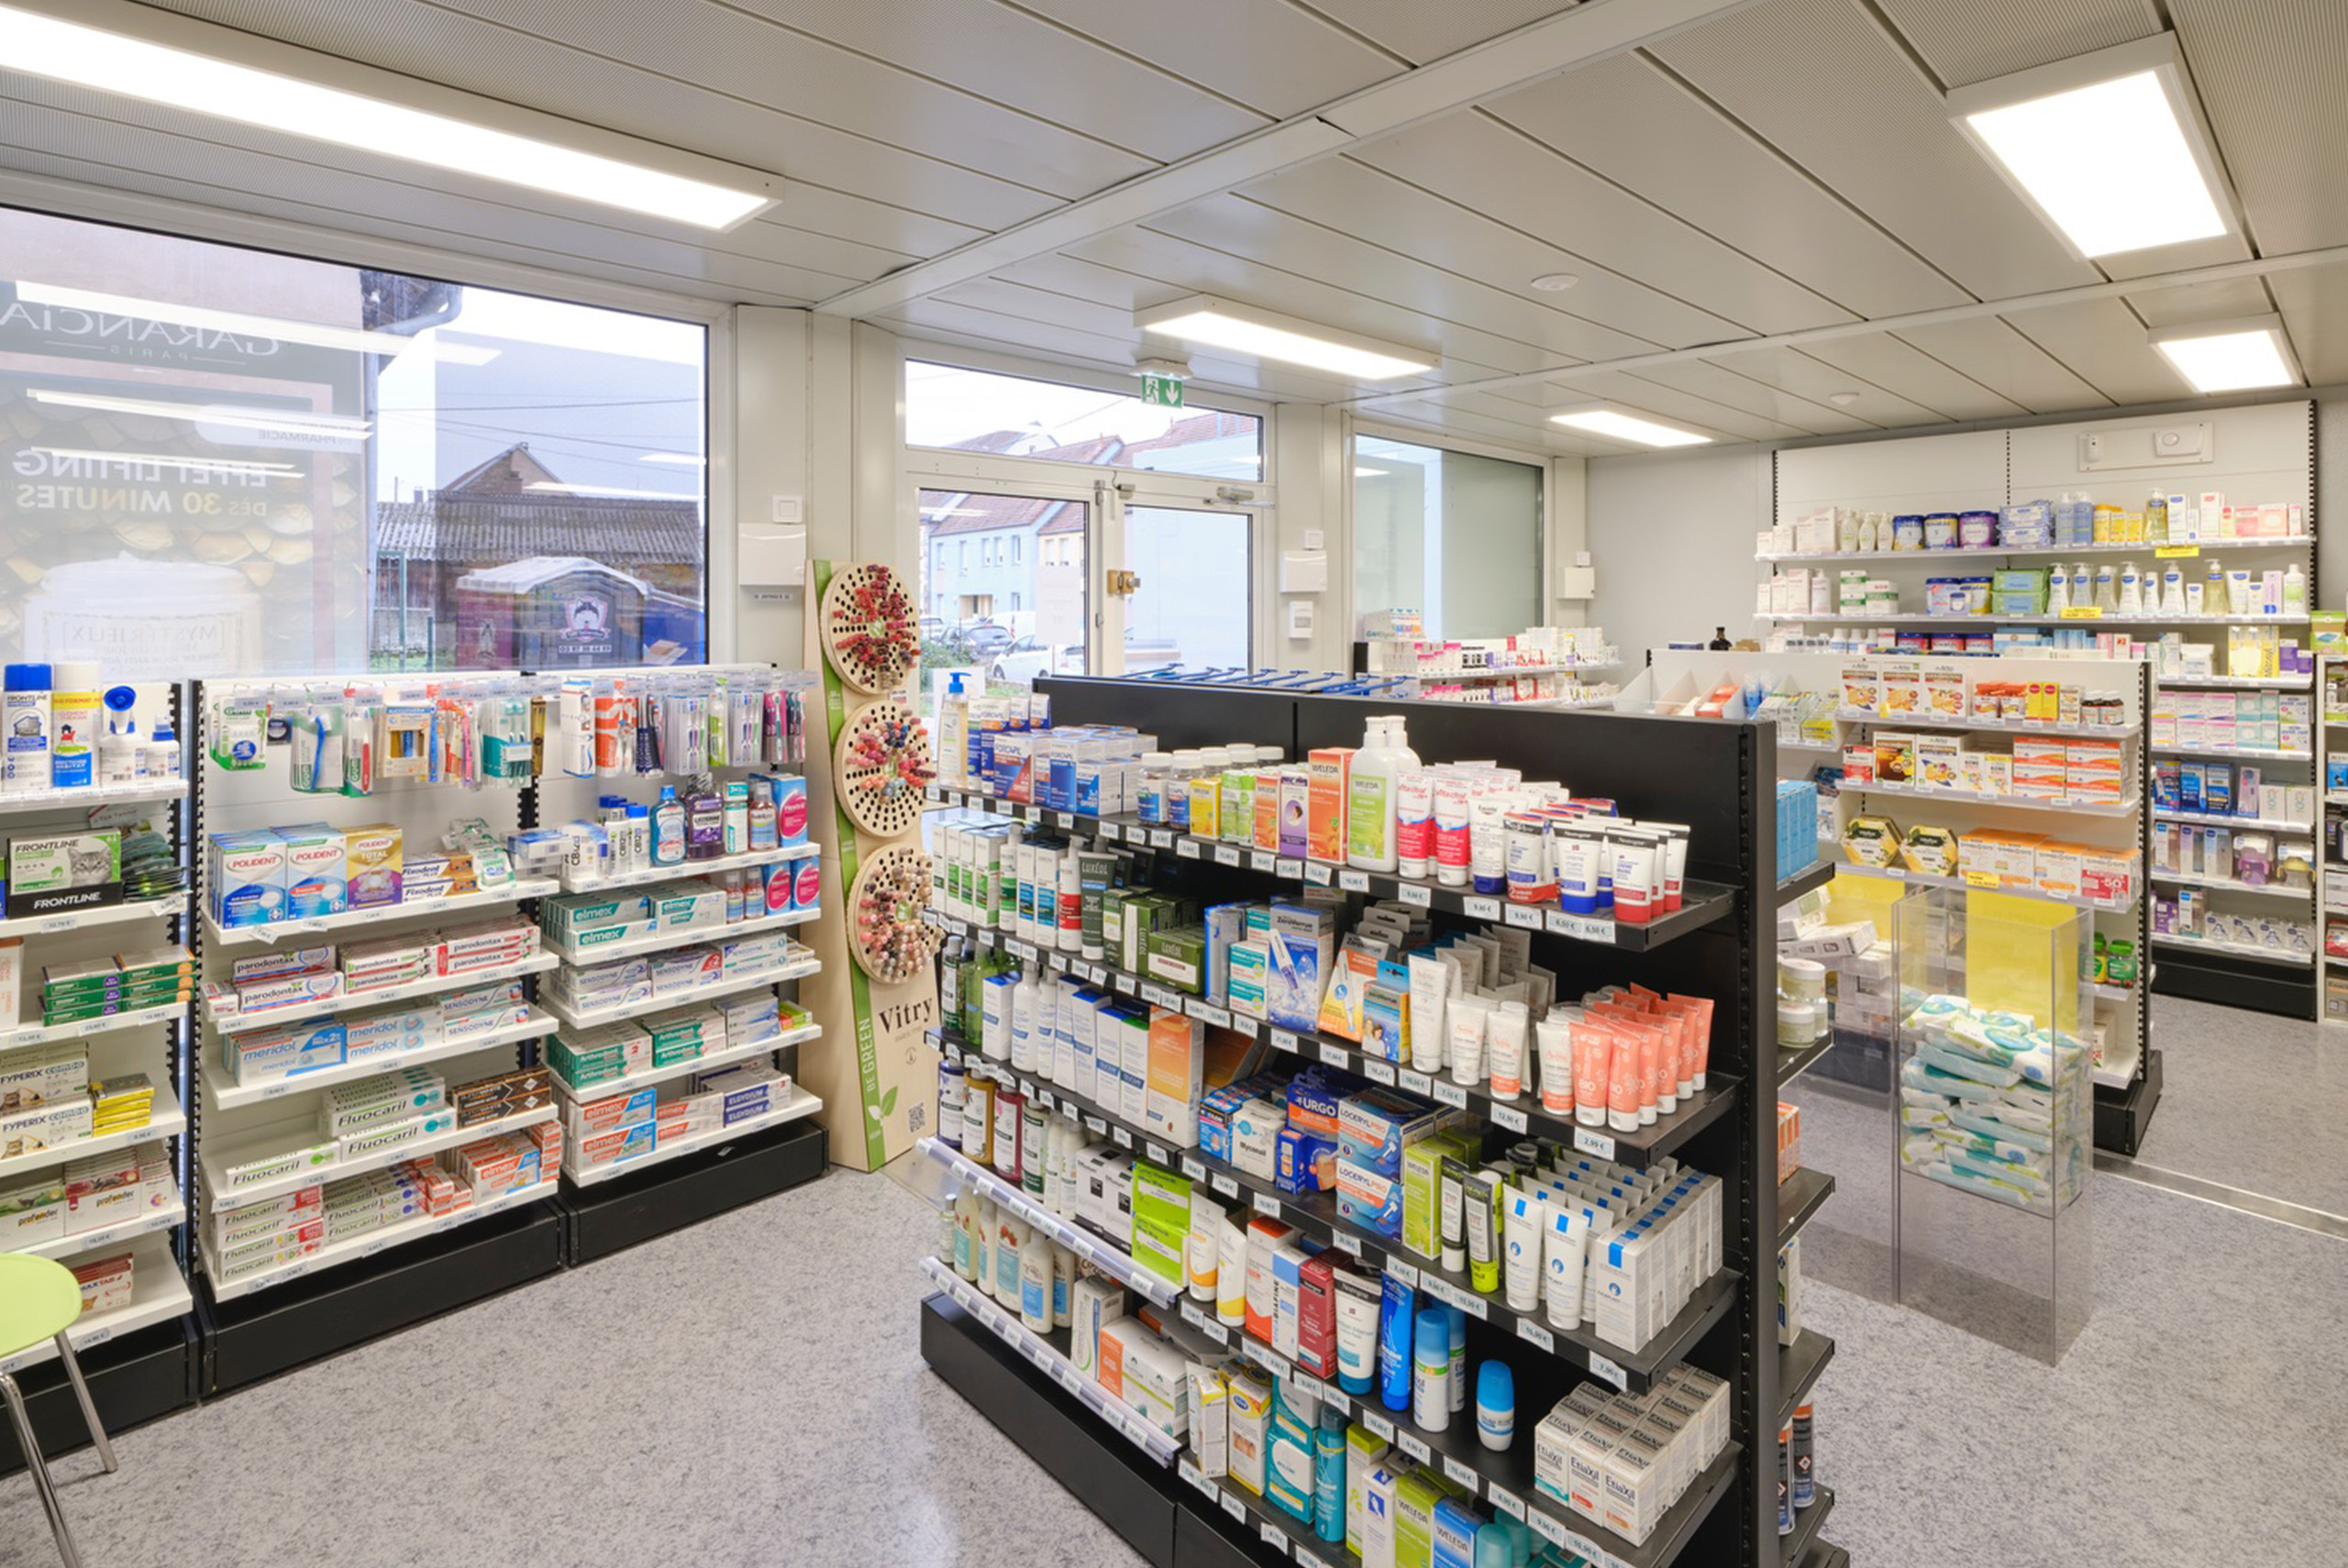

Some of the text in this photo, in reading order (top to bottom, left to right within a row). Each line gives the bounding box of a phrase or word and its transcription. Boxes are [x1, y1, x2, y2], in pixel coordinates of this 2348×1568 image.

[994, 743, 1023, 756] FORCAPIL
[1312, 765, 1339, 774] WELEDA
[1355, 780, 1379, 790] WELEDA
[16, 838, 79, 853] FRONTLINE
[358, 840, 390, 848] POLIDENT
[232, 856, 277, 869] POLIDENT
[295, 849, 338, 861] POLIDENT
[360, 851, 388, 859] TOTAL
[405, 885, 444, 897] Fixodent
[34, 891, 102, 910] FRONTLINE
[663, 900, 692, 913] elmex
[575, 905, 614, 922] elmex
[581, 927, 621, 944] elmex
[454, 936, 503, 953] parodontax
[236, 955, 296, 974] parodontax
[355, 955, 399, 972] parodontax
[453, 953, 503, 969] parodontax
[656, 963, 693, 977] SENSODYNE
[355, 973, 399, 988] parodontax
[580, 972, 618, 986] SENSODYNE
[656, 978, 693, 991] SENSODYNE
[244, 985, 304, 1004] parodontax
[581, 996, 621, 1010] SENSODYNE
[443, 996, 489, 1011] SENSODYNE
[879, 997, 934, 1034] Vitry
[349, 1021, 398, 1039] meridol
[449, 1019, 496, 1036] SENSODYNE
[243, 1042, 296, 1062] meridol
[349, 1040, 398, 1058] meridol
[858, 1017, 876, 1092] BE GREEN
[261, 1057, 296, 1072] meridol
[0, 1068, 44, 1086] FYPERIX
[1578, 1079, 1597, 1092] BIO
[727, 1088, 763, 1105] ELGYDIUM
[338, 1099, 407, 1129] Fluocaril
[584, 1101, 625, 1121] elmex
[657, 1106, 685, 1121] elmex
[727, 1106, 763, 1121] ELGYDIUM
[1302, 1098, 1336, 1117] URGO
[3, 1115, 47, 1133] FYPERIX
[659, 1125, 686, 1140] elmex
[348, 1126, 418, 1154] Fluocaril
[584, 1133, 625, 1153] elmex
[232, 1160, 300, 1187] Fluocaril
[483, 1162, 518, 1180] elmex
[95, 1189, 135, 1209] profender
[17, 1208, 60, 1227] profender
[224, 1201, 284, 1226] Fluocaril
[327, 1198, 382, 1221] Fluocaril
[224, 1219, 284, 1243] Fluocaril
[327, 1216, 382, 1239] Fluocaril
[224, 1238, 274, 1260] Fluocaril
[224, 1256, 274, 1278] Fluocaril
[1398, 1499, 1429, 1524] WELEDA
[1436, 1527, 1468, 1552] WELEDA
